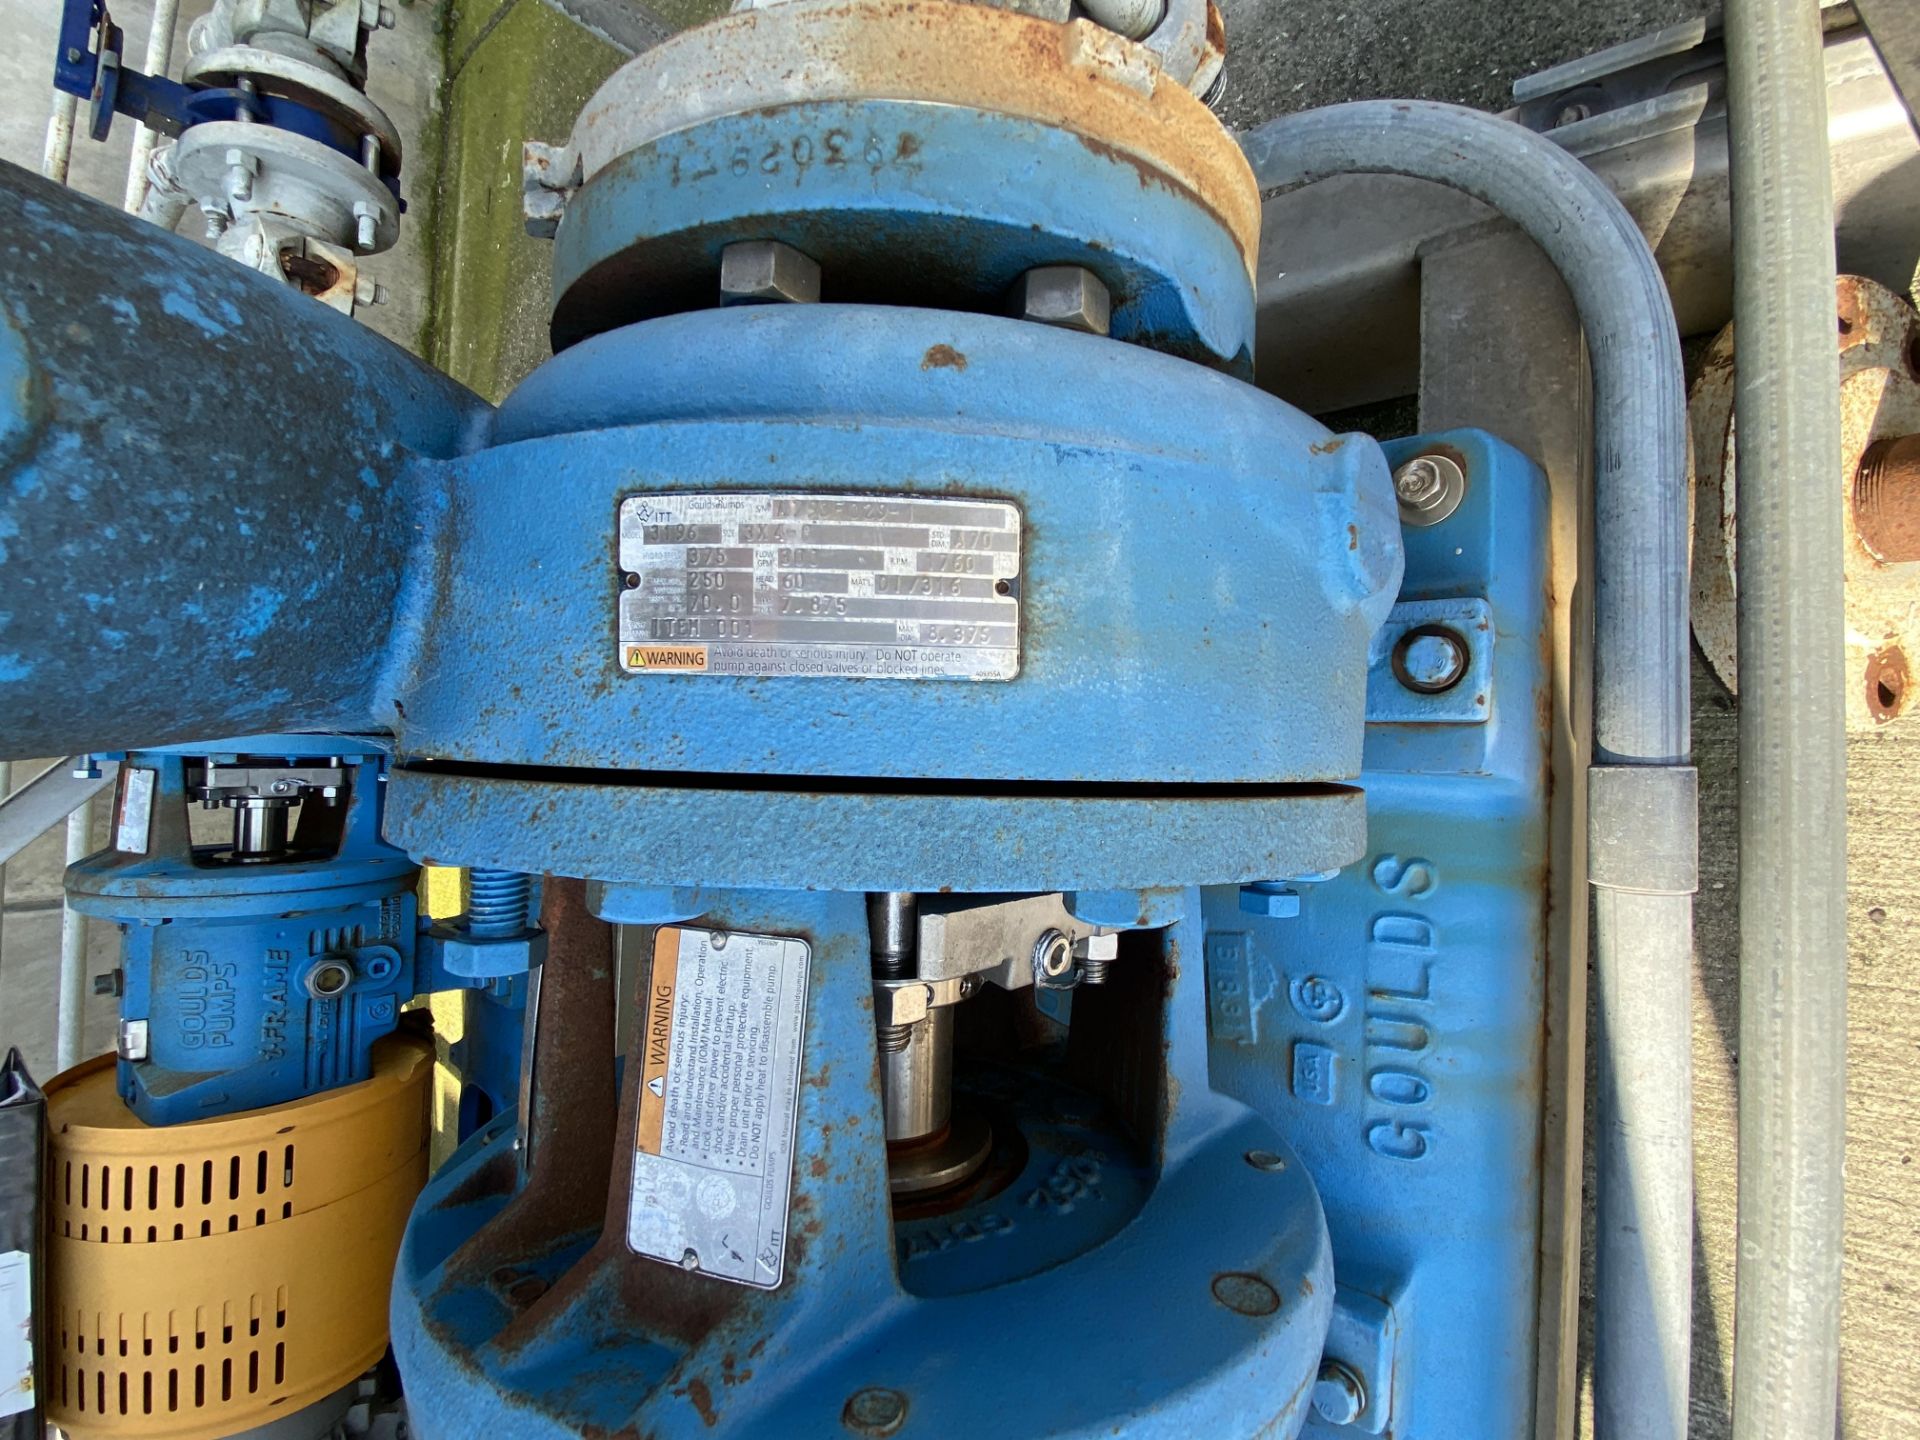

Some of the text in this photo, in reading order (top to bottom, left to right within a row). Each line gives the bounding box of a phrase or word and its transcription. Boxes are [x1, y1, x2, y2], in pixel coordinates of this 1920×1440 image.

[655, 511, 671, 522] ITT
[650, 523, 697, 541] 3196
[687, 546, 729, 565] 375
[688, 570, 725, 590] 250
[782, 572, 804, 591] 60
[689, 592, 743, 613] 70.0
[779, 594, 847, 616] 7.875
[651, 617, 701, 638] ITEM
[718, 617, 753, 638] 001
[927, 624, 991, 645] 8.375
[646, 650, 704, 666] WARNING
[714, 645, 743, 656] Avoid
[746, 646, 776, 658] death
[780, 649, 790, 658] or
[795, 647, 832, 659] serious
[876, 649, 891, 660] Do
[894, 649, 917, 661] NOT
[920, 650, 961, 664] operate
[714, 661, 744, 672] pump
[747, 660, 785, 675] against
[789, 660, 823, 672] closed
[826, 661, 859, 673] valves
[862, 664, 871, 673] or
[876, 662, 917, 674] blocked
[180, 950, 208, 1049] GOULDS
[208, 962, 237, 1049] PUMPS
[1367, 854, 1436, 1162] GOULDS
[649, 984, 672, 1066] WARNING
[734, 1001, 750, 1049] protective
[679, 939, 708, 1147] Read and understand Installation, Operation
[701, 960, 728, 1152] Lock out driver power to prevent electric
[664, 993, 689, 1153] Avoid death or serious injury:
[690, 994, 713, 1149] and Maintenance (IOM) Manual.
[730, 1051, 744, 1093] personal
[748, 962, 778, 1160] Do NOT apply heat to disassemble pump.
[786, 1055, 795, 1086] obtained
[1303, 1053, 1322, 1095] USA
[713, 1001, 737, 1154] shock and/or accidental startup.
[744, 1069, 753, 1081] to
[741, 1083, 754, 1107] prior
[728, 1094, 740, 1128] proper
[740, 1108, 750, 1129] unit
[781, 1112, 790, 1138] Manual
[724, 1129, 735, 1156] Wear
[736, 1130, 748, 1157] Drain
[780, 1139, 788, 1154] IOM
[763, 1150, 776, 1210] GOULDS PUMPS
[770, 1228, 780, 1247] ITT
